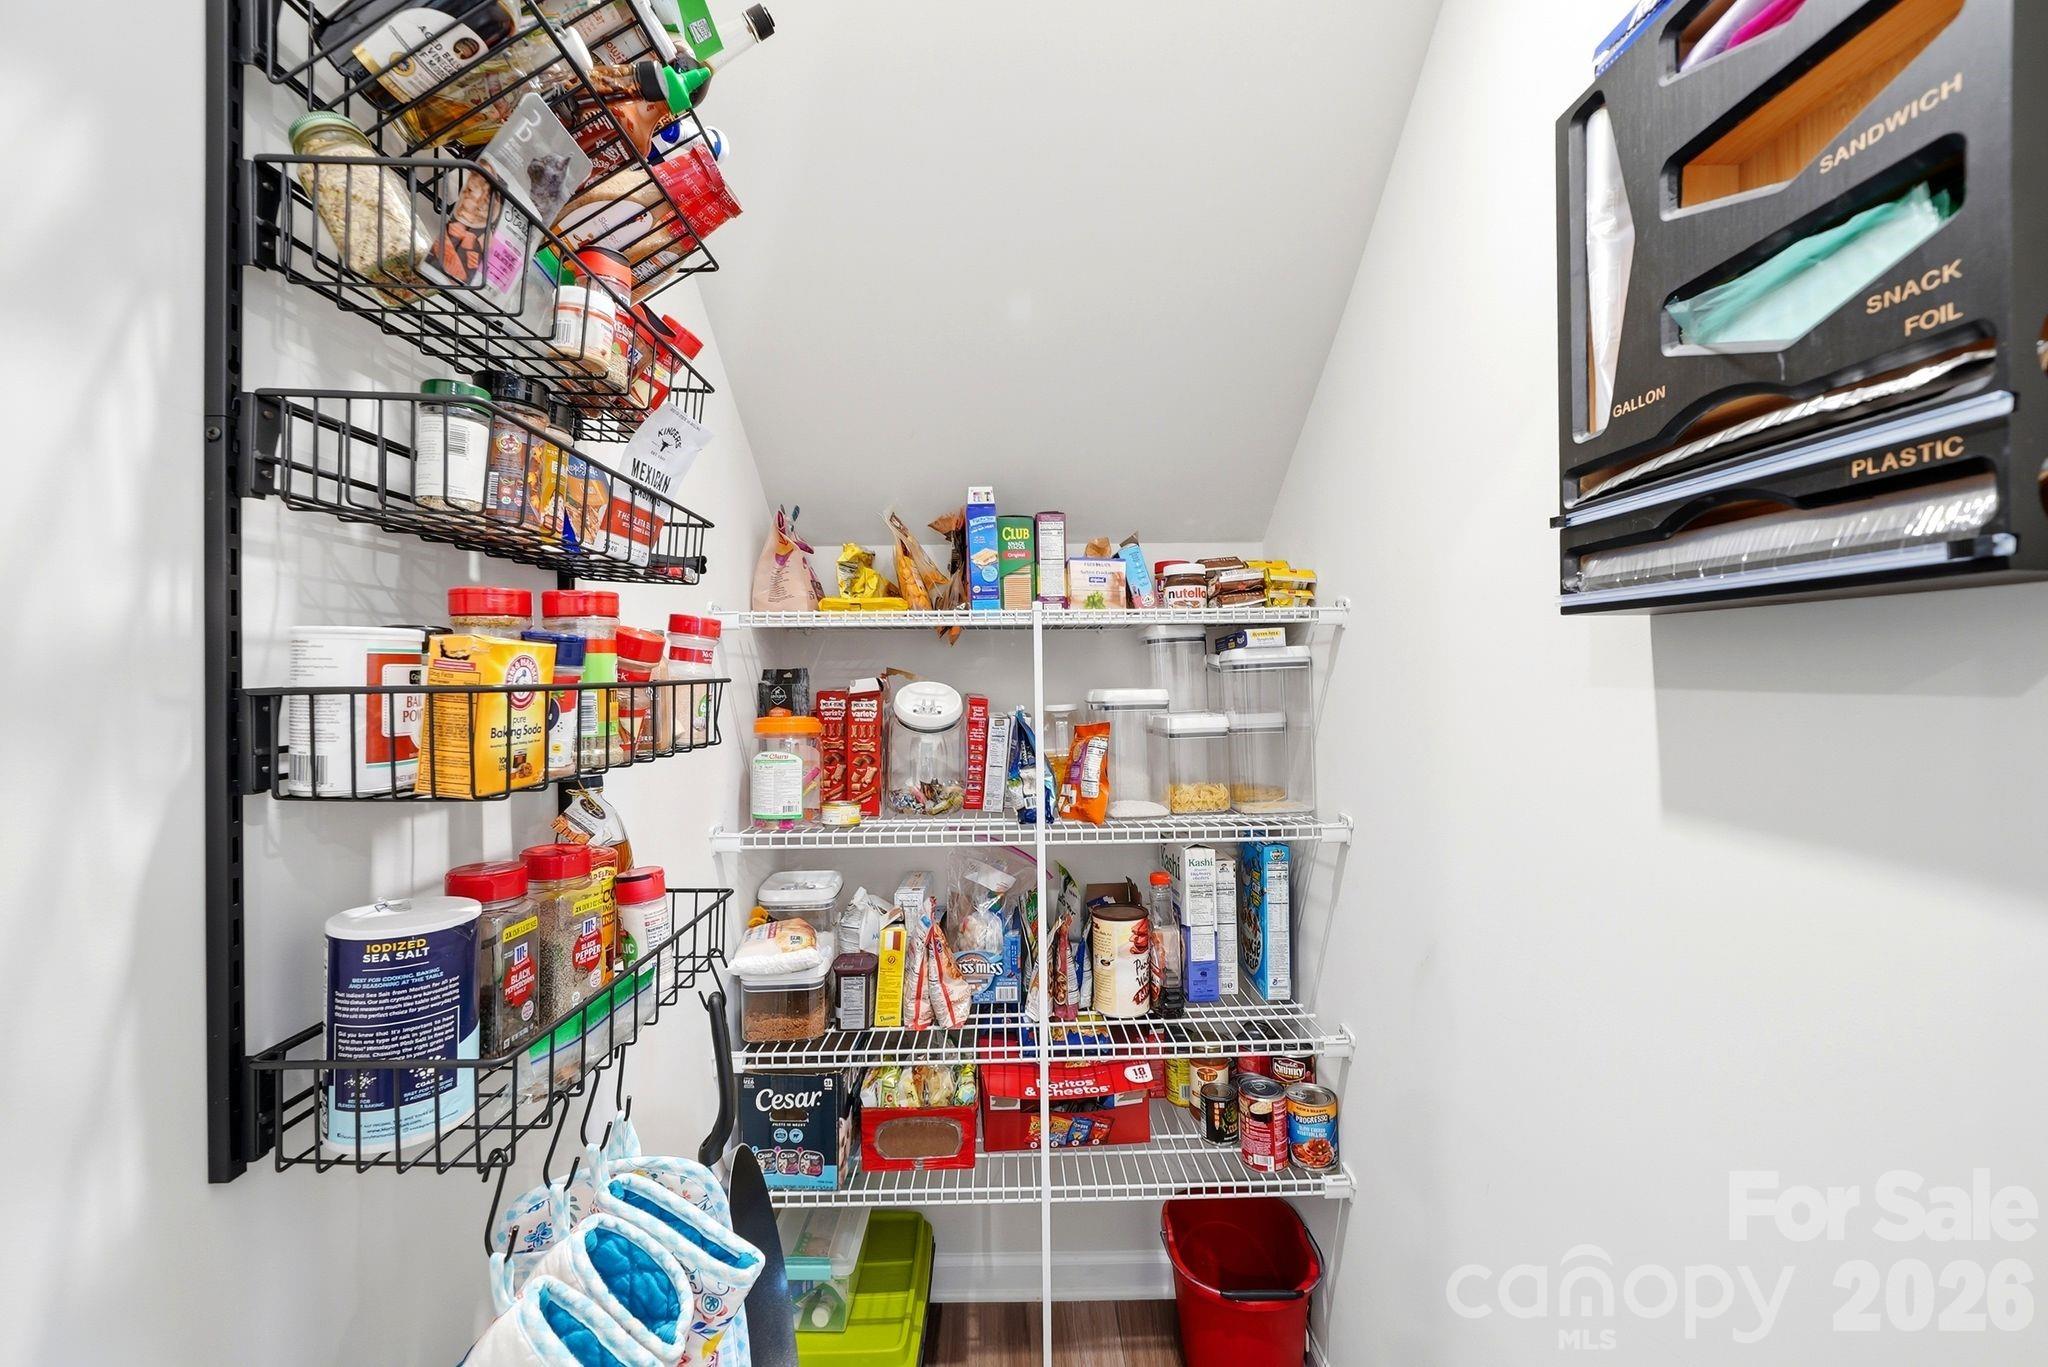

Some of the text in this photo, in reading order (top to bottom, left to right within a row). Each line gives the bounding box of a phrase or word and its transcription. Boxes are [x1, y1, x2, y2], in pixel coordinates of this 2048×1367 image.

[1819, 72, 1963, 175] SANDWICH
[1866, 258, 1963, 315] SNACK
[1904, 302, 1964, 337] FOIL
[1612, 385, 1667, 418] GALLON
[1851, 435, 1965, 480] PLASTIC
[631, 457, 671, 494] MEXICAN
[1002, 527, 1030, 540] CLUB
[1168, 587, 1206, 599] nutella
[513, 716, 527, 727] pure
[522, 724, 542, 736] Soda
[1188, 857, 1213, 867] Kashi
[366, 938, 427, 953] IODIZED
[575, 944, 601, 962] PEPPER
[362, 947, 430, 963] SEA SALT
[511, 967, 532, 984] BLACK
[1132, 1067, 1146, 1076] 18
[1025, 1087, 1036, 1096] &
